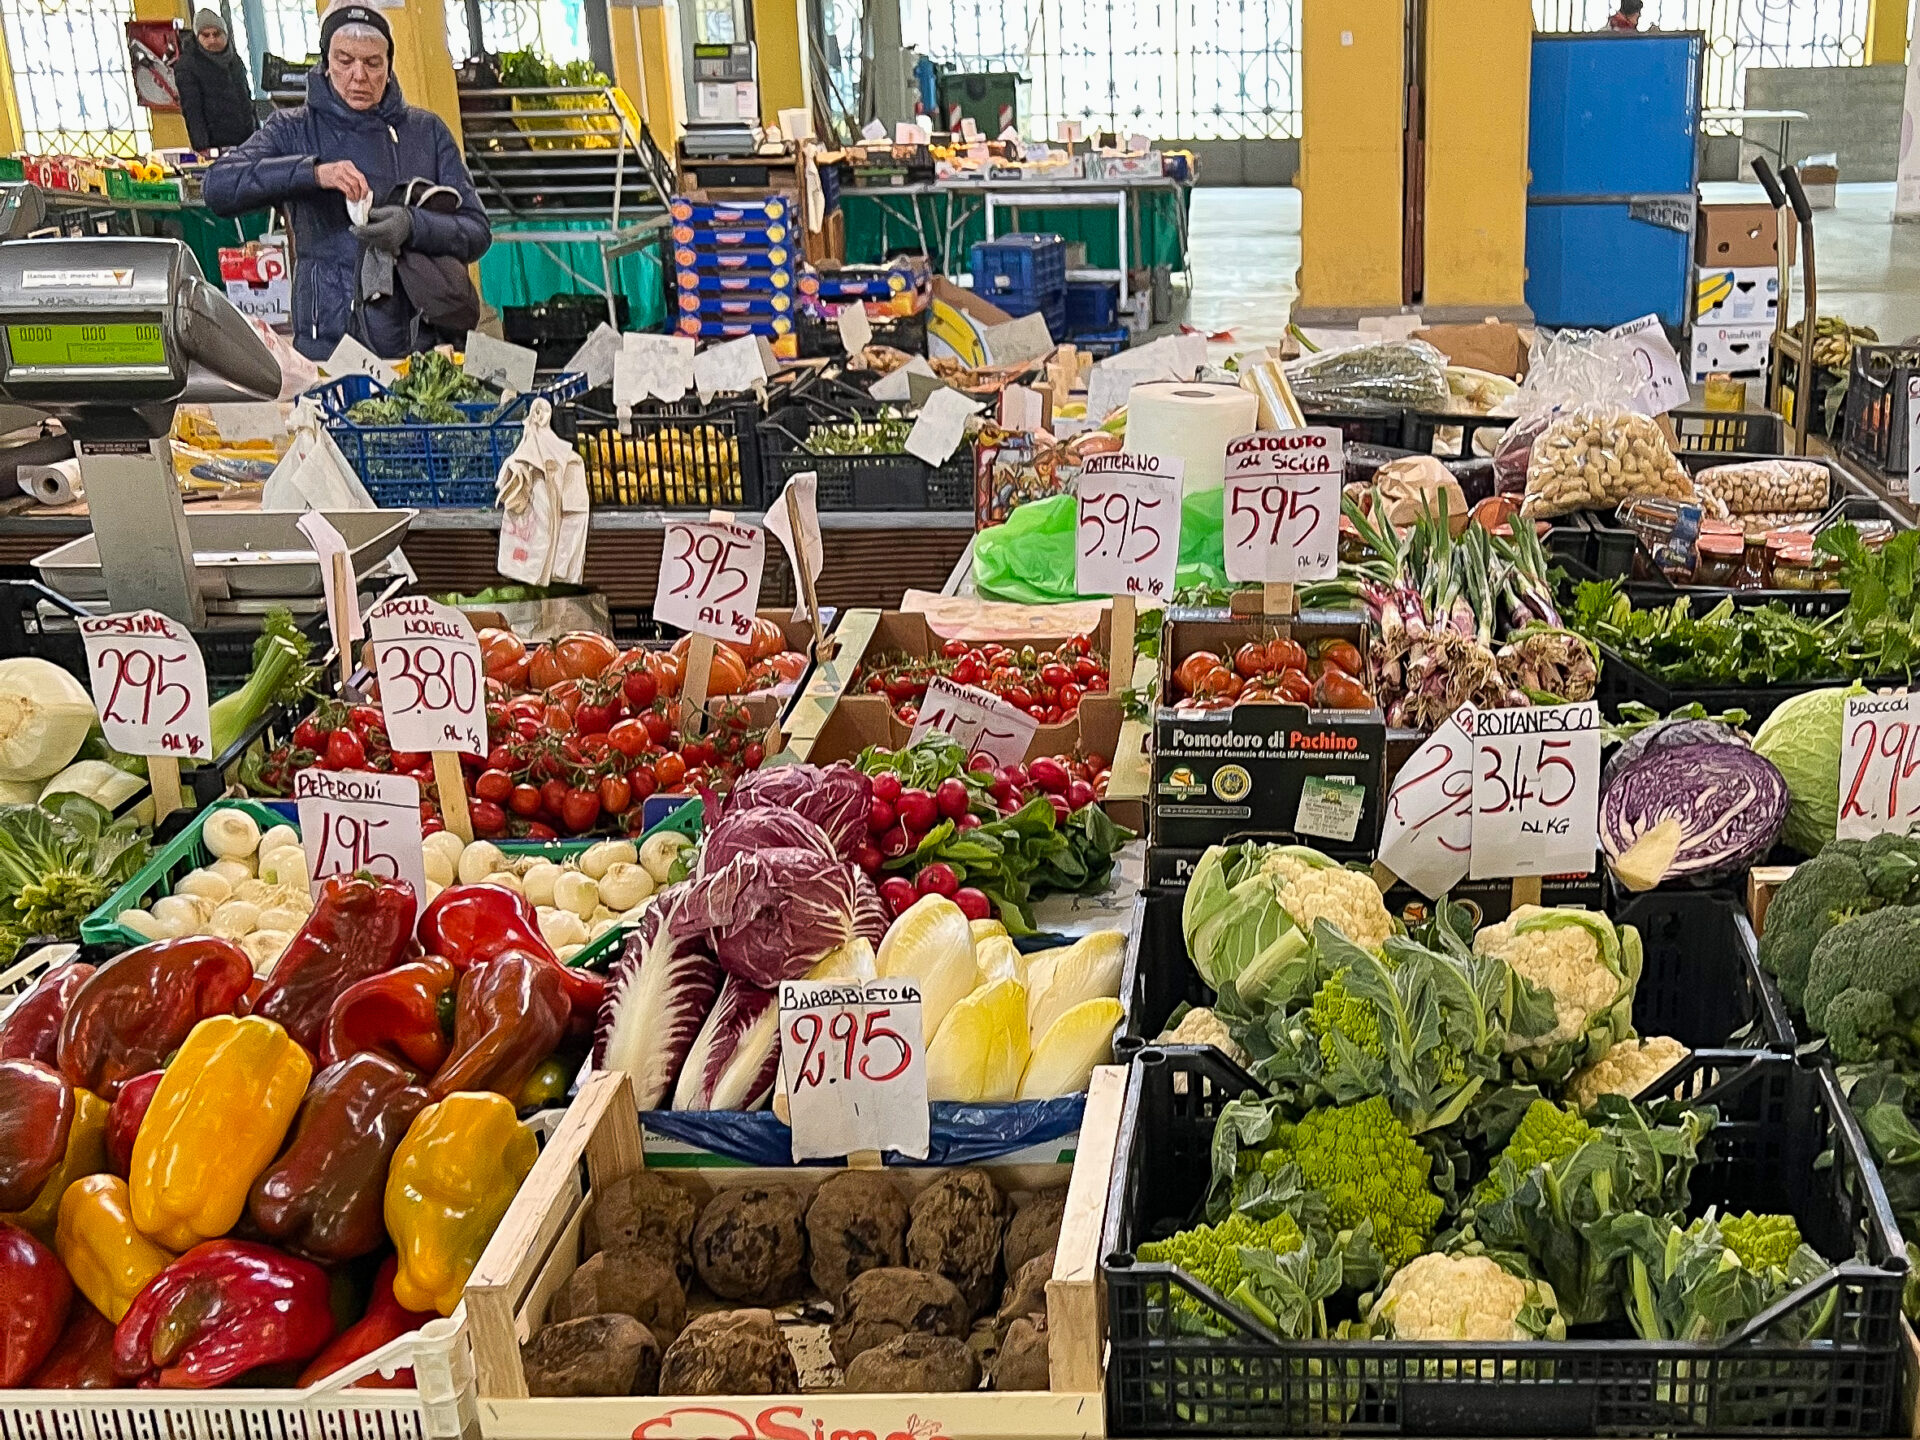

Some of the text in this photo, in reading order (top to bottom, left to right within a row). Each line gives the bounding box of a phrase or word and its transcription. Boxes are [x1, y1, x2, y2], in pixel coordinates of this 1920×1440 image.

[1226, 434, 1327, 457] COSTOLUTO
[1080, 492, 1161, 563] 5.95
[1231, 486, 1321, 550] 5.95
[669, 525, 749, 604] 3.95
[404, 619, 464, 640] NOVELLE
[698, 606, 724, 625] AL
[98, 648, 191, 726] 2.95
[381, 645, 477, 715] 3.80
[1172, 728, 1358, 750] Pomodoro di Pachino
[1478, 739, 1577, 813] 3.45
[790, 1008, 912, 1094] 2.95
